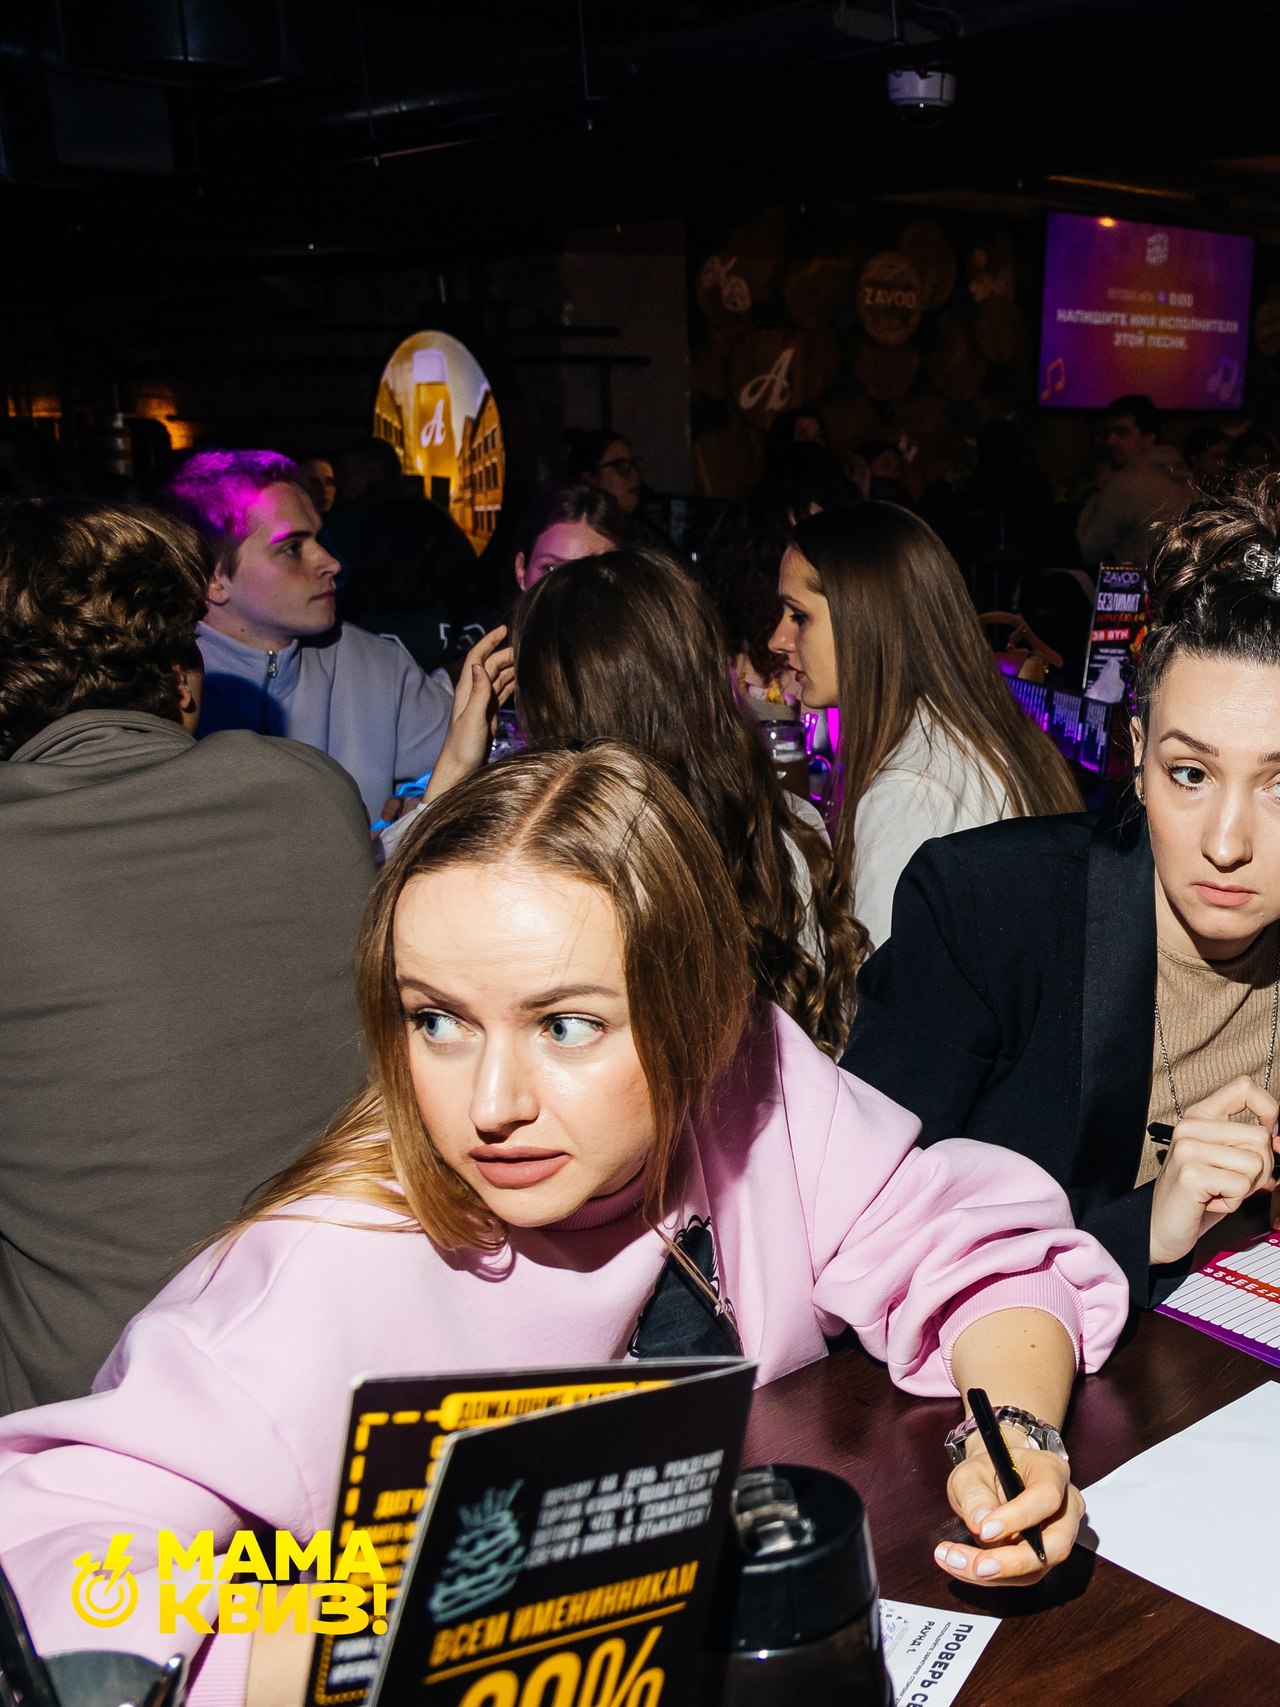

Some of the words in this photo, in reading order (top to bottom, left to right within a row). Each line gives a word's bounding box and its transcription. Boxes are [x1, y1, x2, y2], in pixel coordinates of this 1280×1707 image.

[1056, 308, 1127, 327] НАПИШИТЕ
[1158, 315, 1240, 333] ИСПОЛНИТЕЛЯ
[1113, 330, 1146, 348] ЭТОЙ
[1103, 570, 1141, 585] ZAVOD
[1097, 592, 1141, 612] БЕЗЛИМИТ
[1212, 1270, 1227, 1278] Ю
[1231, 1278, 1249, 1286] Щ
[428, 1610, 511, 1669] ВСЕМ
[510, 1560, 699, 1643] ИМЕНИННИКАМ
[909, 1620, 936, 1647] РАУНД
[920, 1623, 974, 1689] ПРОВЕРЬ
